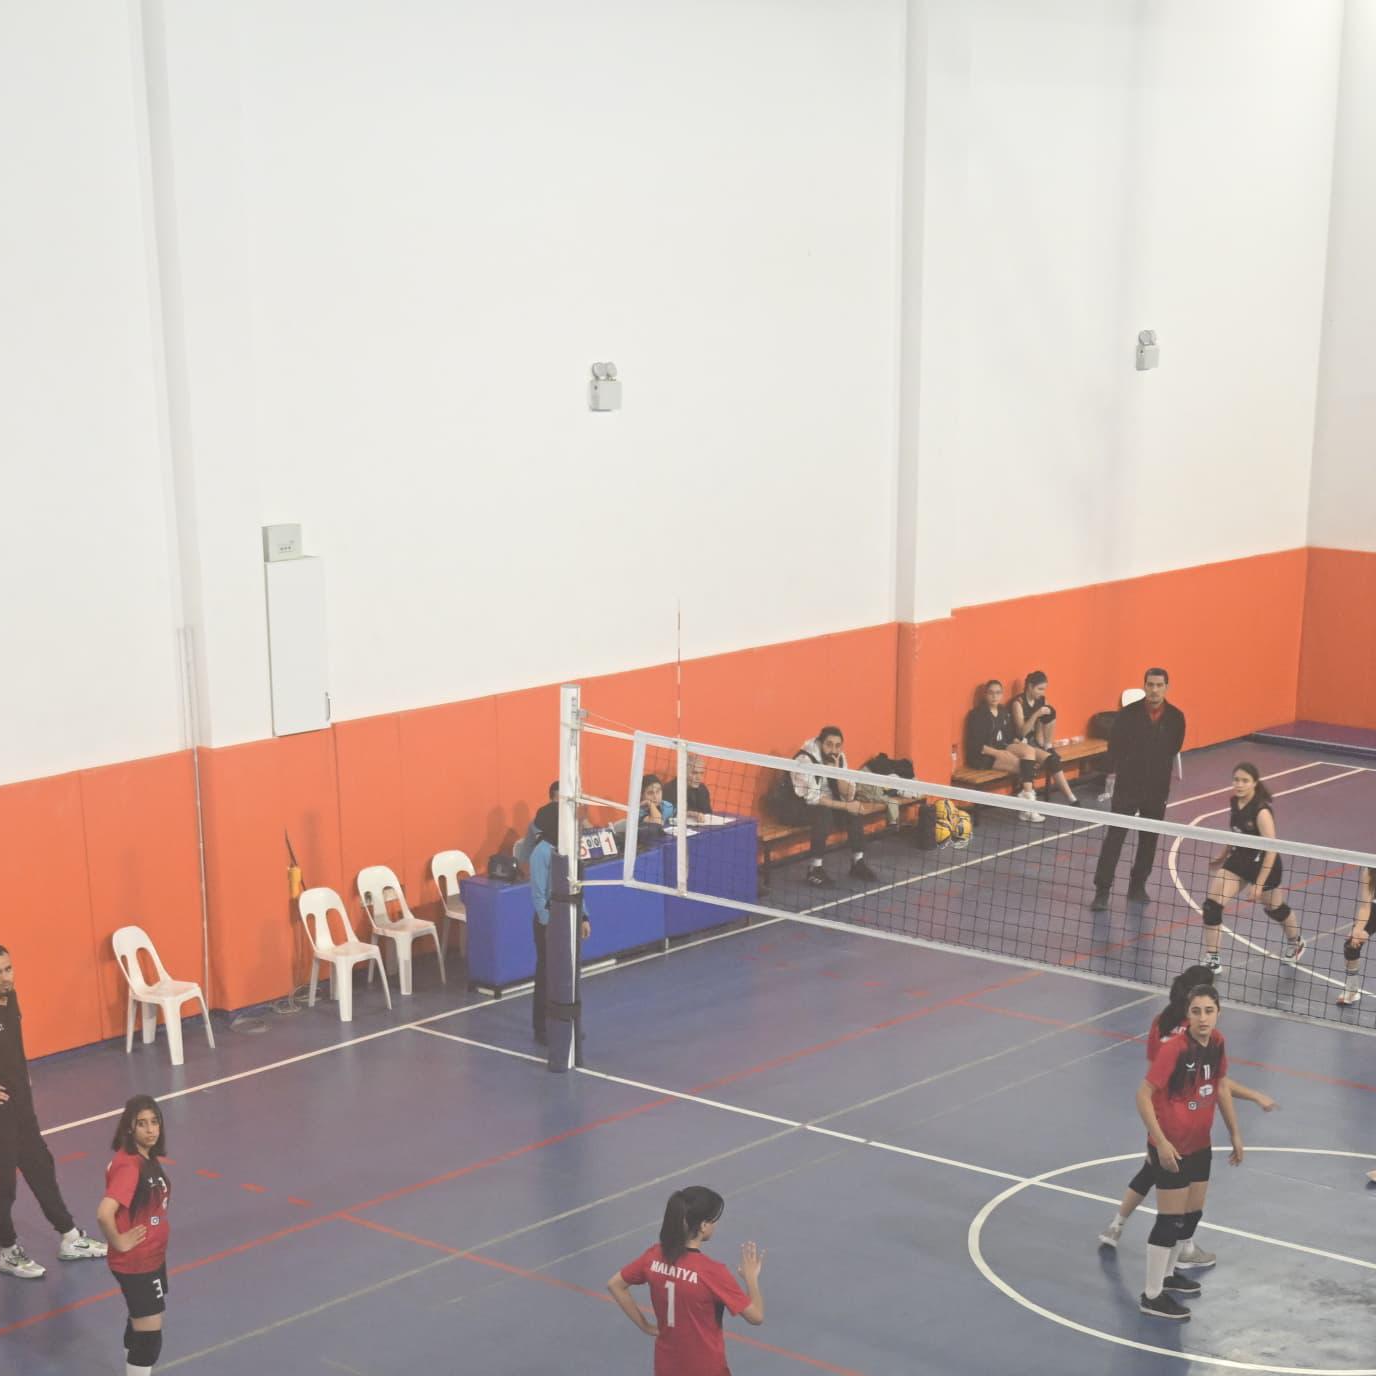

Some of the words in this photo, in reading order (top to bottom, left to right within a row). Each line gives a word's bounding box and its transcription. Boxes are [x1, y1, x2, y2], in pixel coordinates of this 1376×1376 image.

[1203, 1064, 1211, 1081] 11
[650, 1260, 698, 1285] MALATYA
[152, 1278, 164, 1299] 3
[664, 1280, 675, 1328] 1
